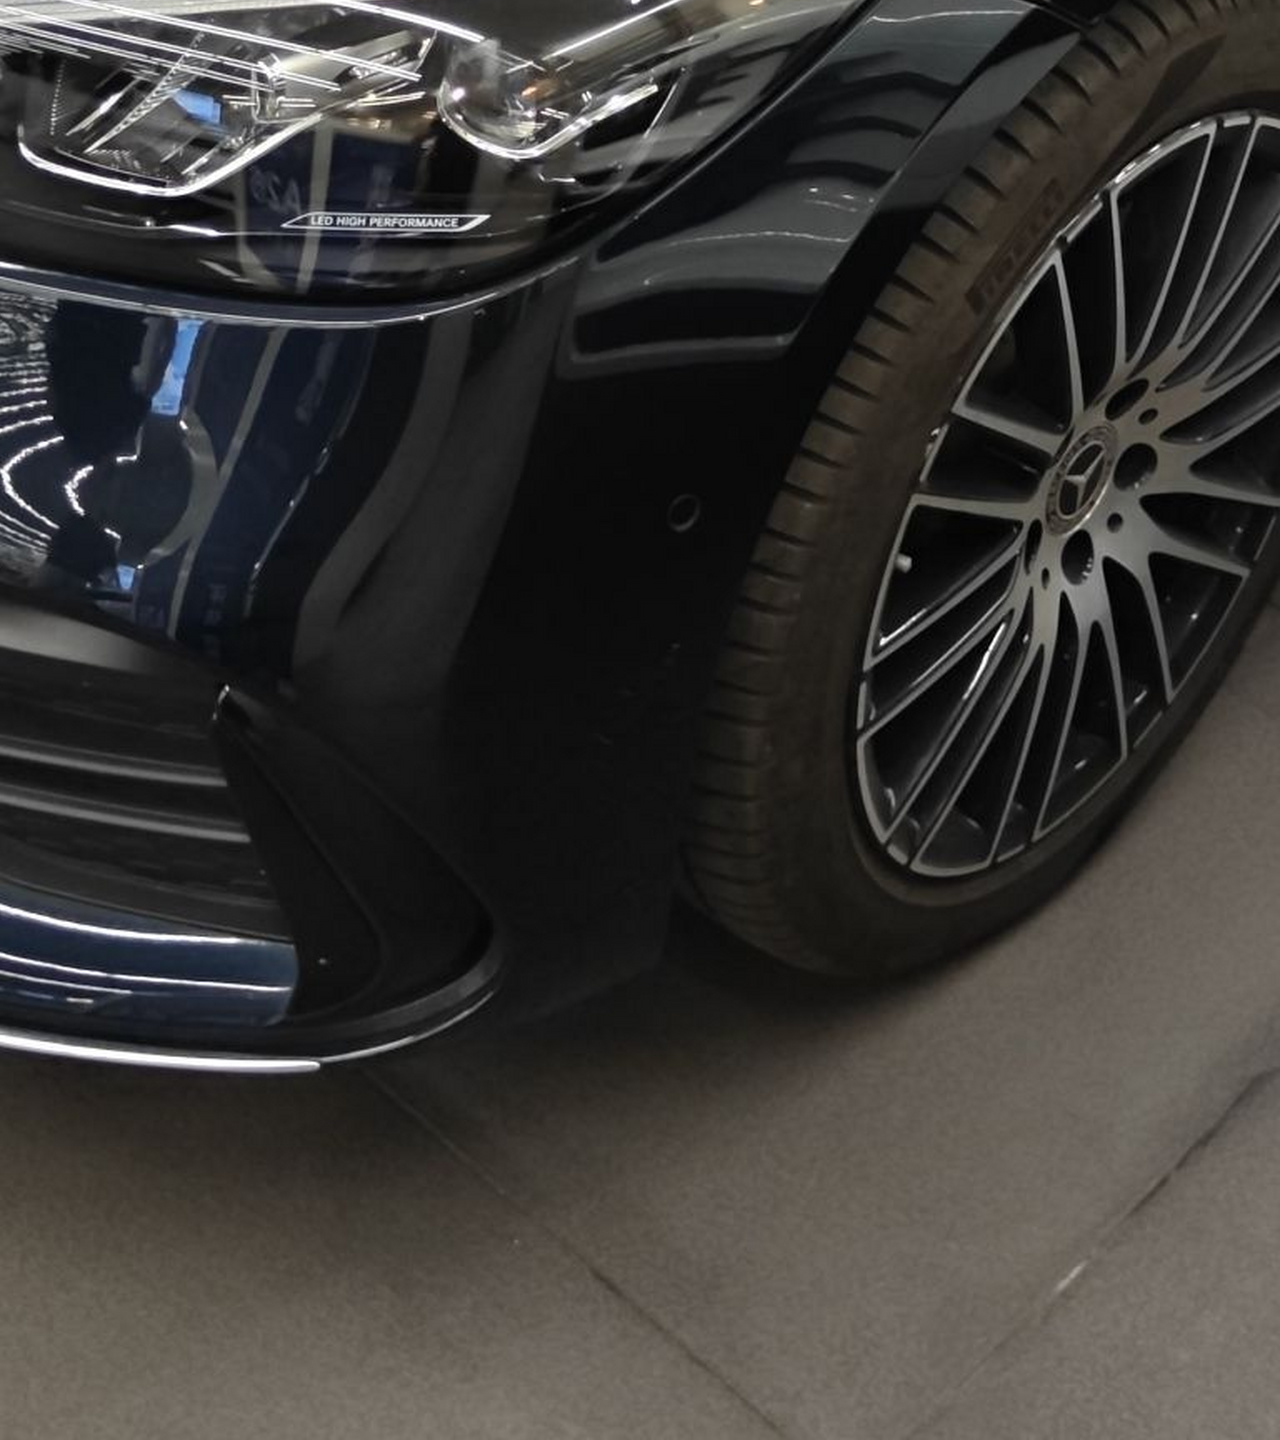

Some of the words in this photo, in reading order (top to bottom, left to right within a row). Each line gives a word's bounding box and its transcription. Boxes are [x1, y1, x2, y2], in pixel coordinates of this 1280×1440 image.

[310, 215, 333, 226] LED
[336, 217, 366, 227] HIGH
[369, 217, 459, 228] PERFORMANCE
